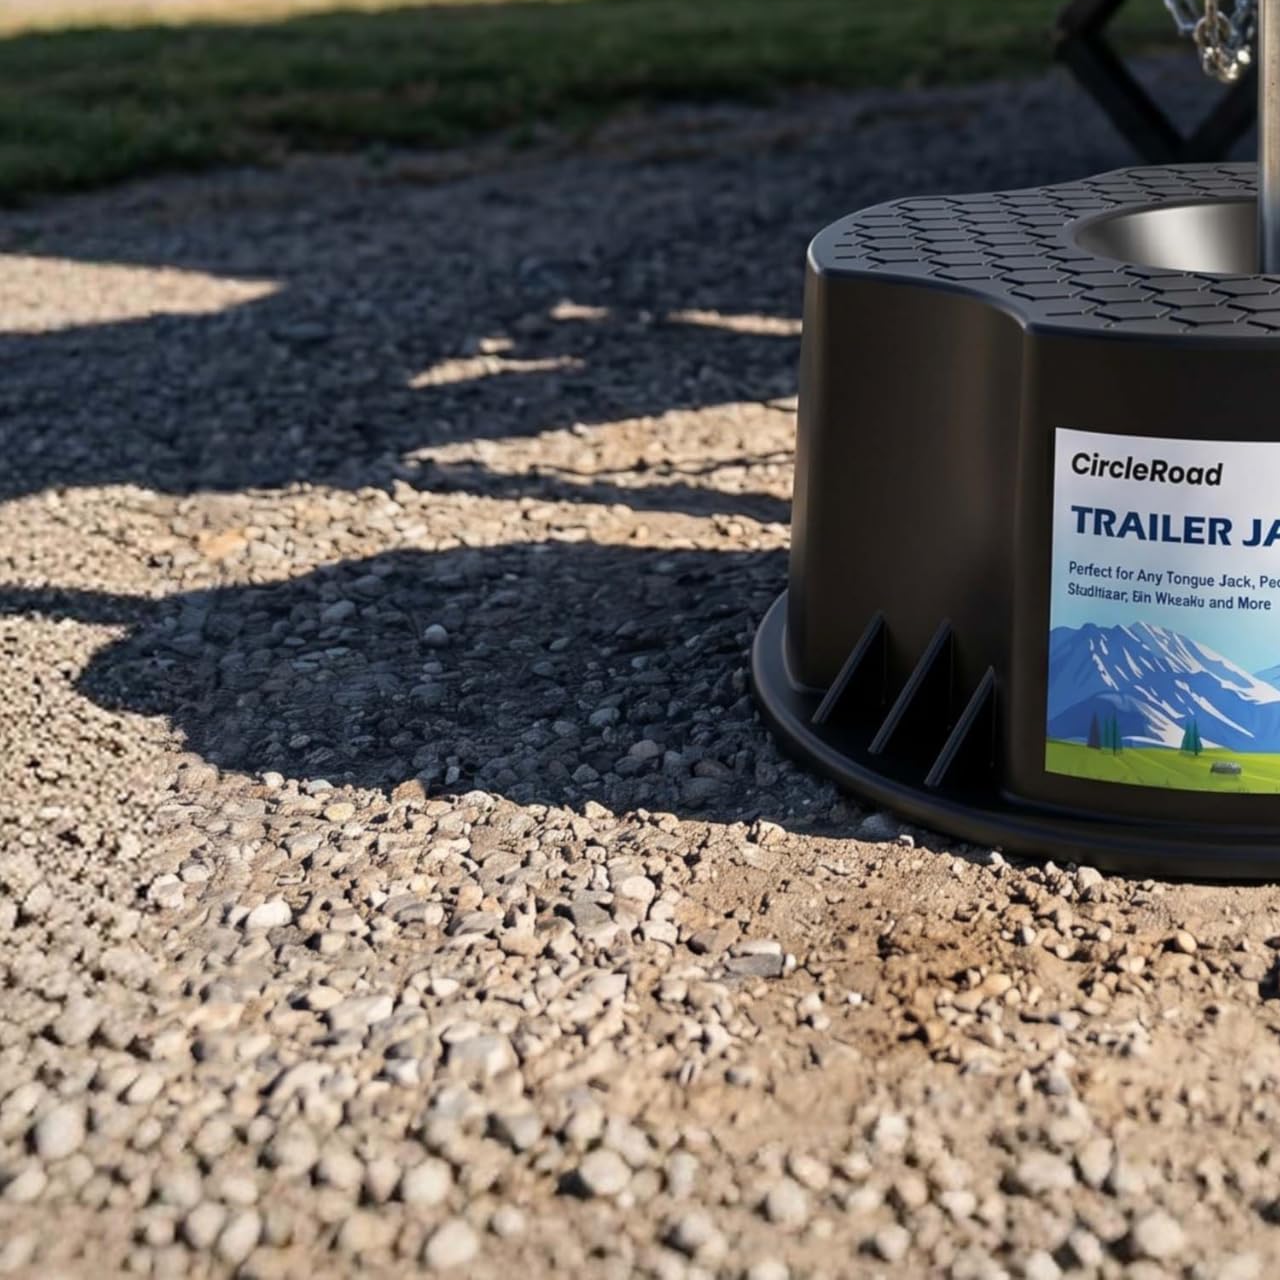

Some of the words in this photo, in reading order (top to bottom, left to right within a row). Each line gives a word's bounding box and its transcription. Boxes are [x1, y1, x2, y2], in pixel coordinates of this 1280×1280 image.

[1071, 452, 1223, 486] CircleRoad
[1071, 505, 1232, 545] TRAILER
[1069, 560, 1112, 579] Perfect
[1116, 566, 1134, 580] for
[1137, 569, 1163, 586] Any
[1166, 571, 1215, 589] Tongue
[1218, 574, 1256, 590] Jack,
[1208, 596, 1234, 609] and
[1238, 596, 1272, 610] More
